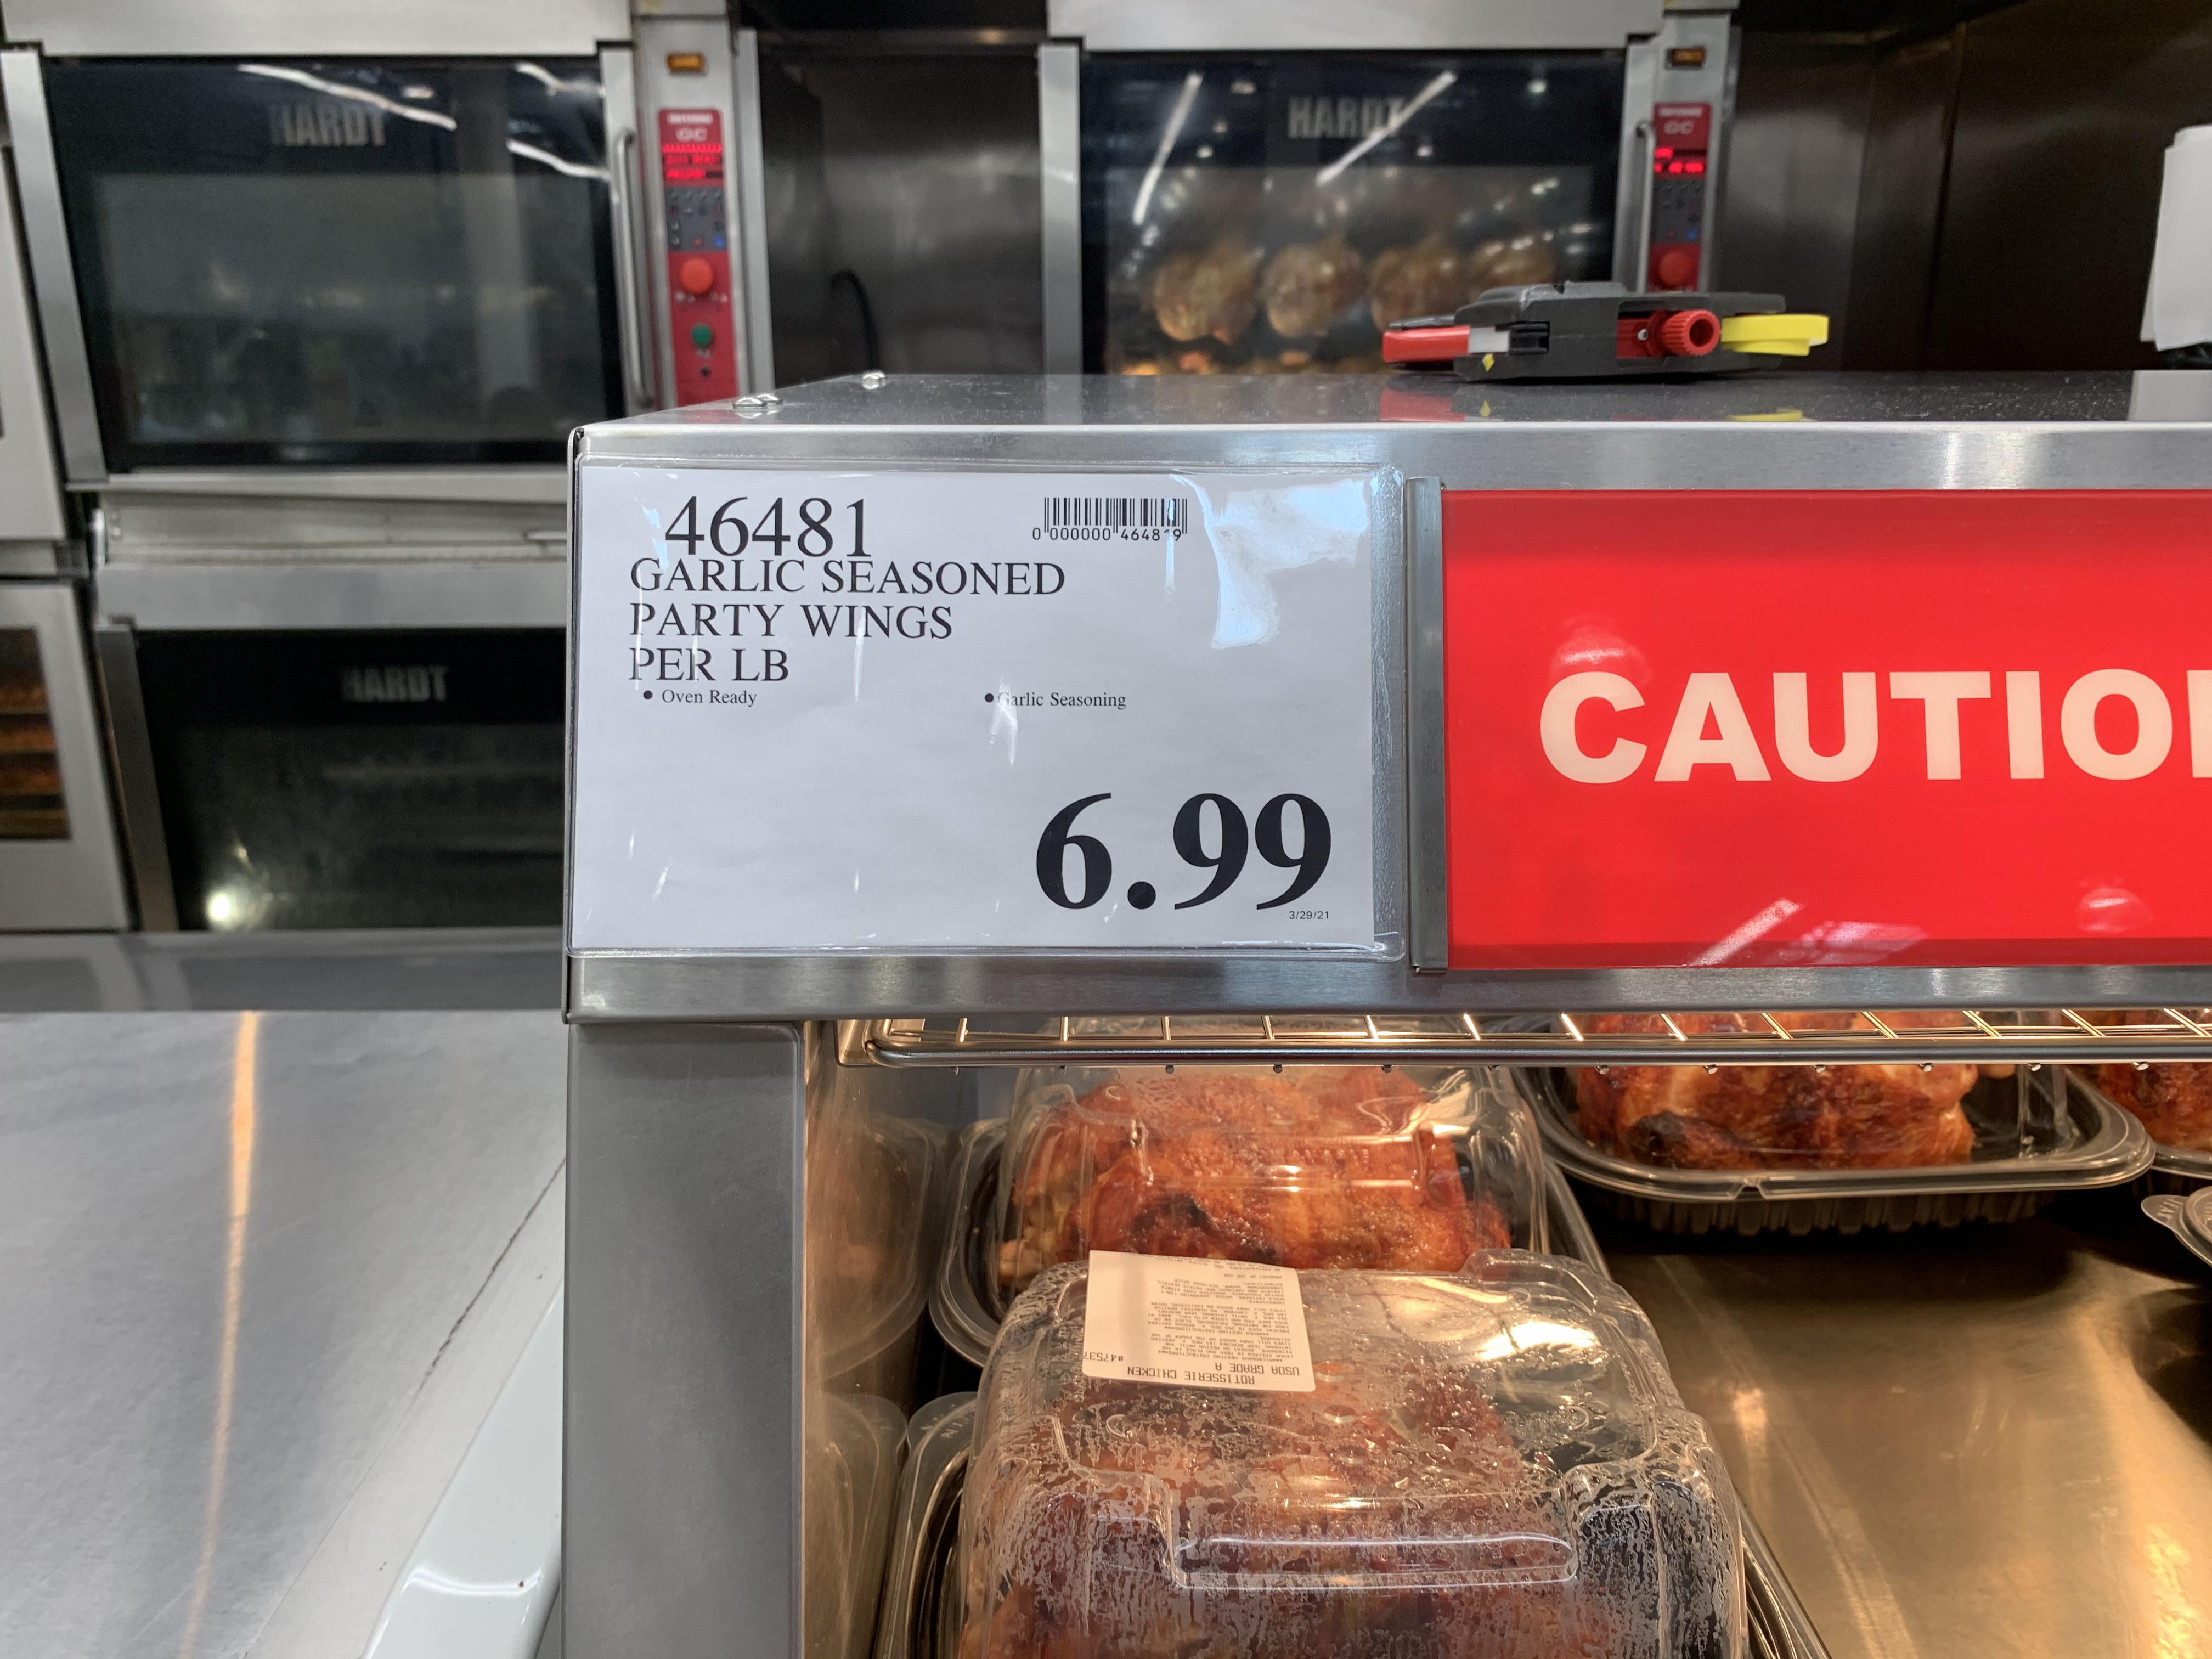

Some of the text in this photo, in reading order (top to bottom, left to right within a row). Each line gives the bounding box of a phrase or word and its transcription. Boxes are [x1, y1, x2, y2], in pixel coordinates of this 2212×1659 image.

[665, 496, 871, 557] 46481
[631, 558, 1065, 595] GARLIC SEASONED
[629, 603, 952, 639] PARTY WINGS
[629, 647, 789, 681] PER LB
[662, 689, 757, 708] Oven Ready
[1050, 692, 1126, 710] Seasoning
[1540, 668, 2212, 783] CAUTIO
[1036, 792, 1331, 910] 6.99
[1289, 911, 1329, 919] 3/29/21
[1127, 1365, 1254, 1384] ROTISSERIE CHICKEN
[1214, 1362, 1300, 1375] USDA GRADE A
